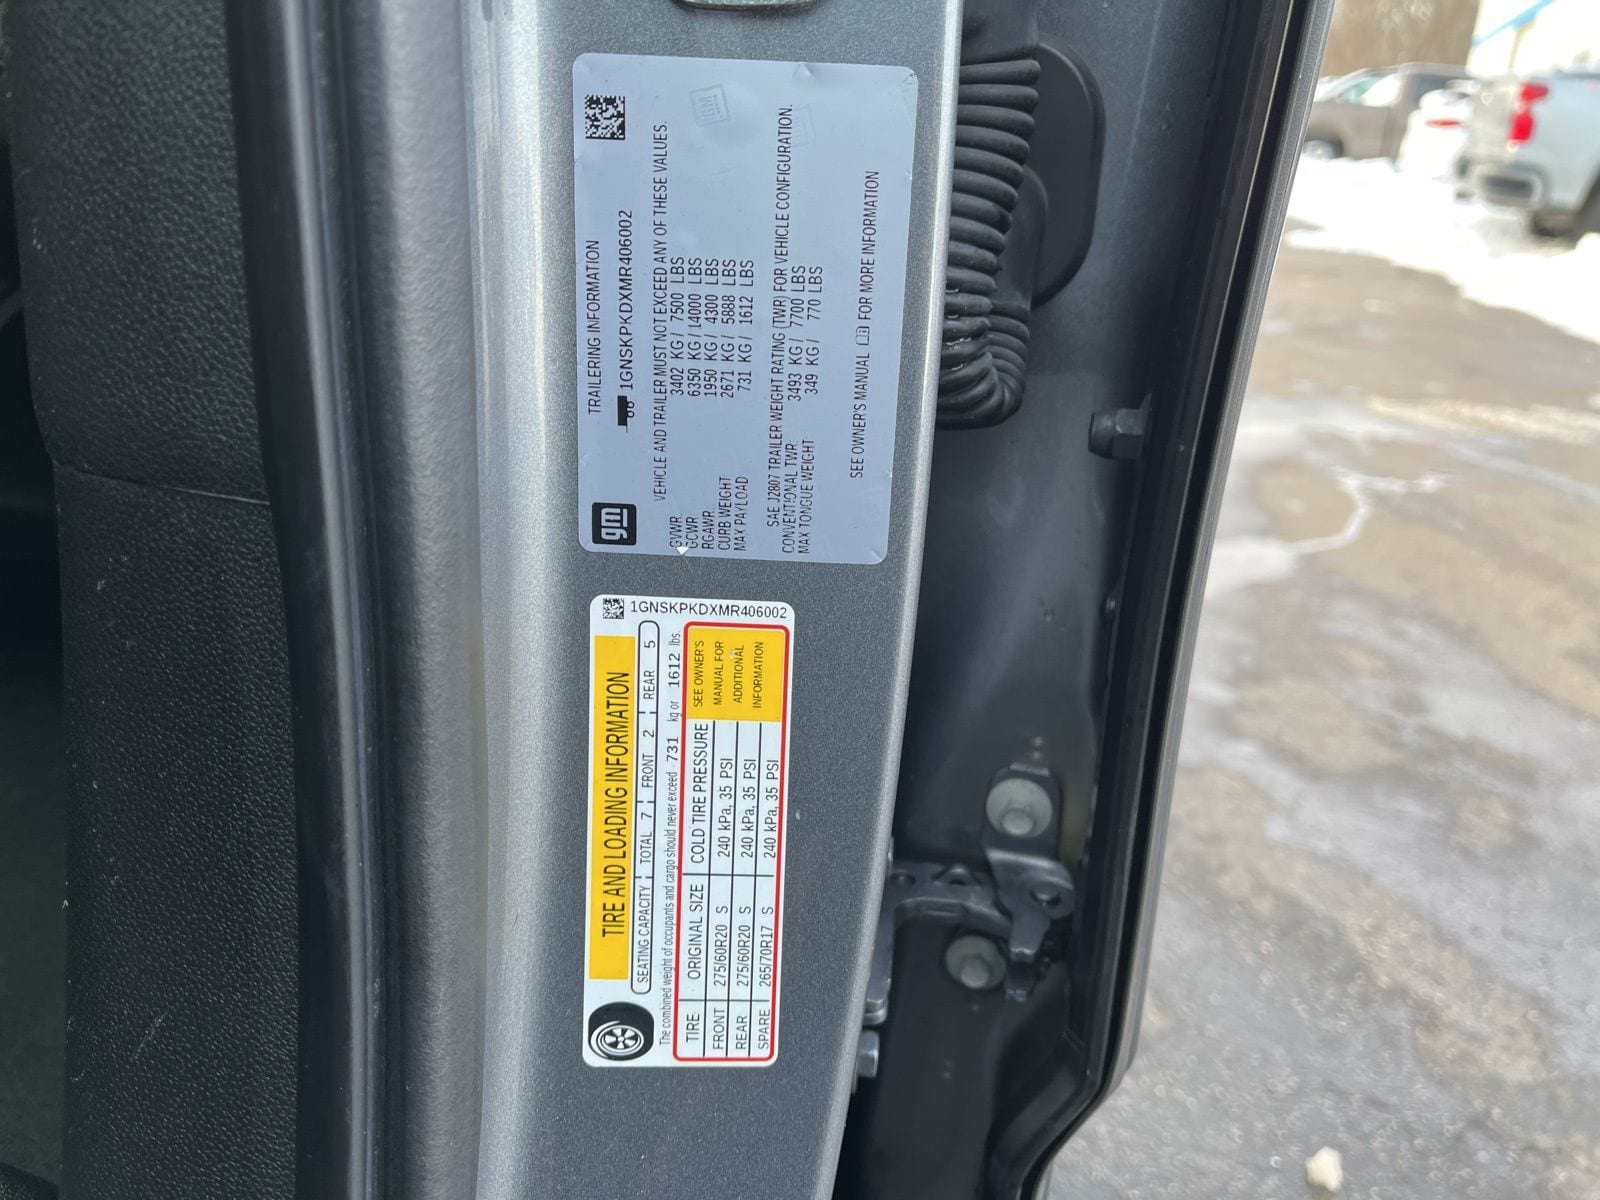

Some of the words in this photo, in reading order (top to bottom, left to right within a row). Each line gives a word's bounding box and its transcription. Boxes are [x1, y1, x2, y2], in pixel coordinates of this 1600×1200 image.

[653, 121, 667, 172] VALUES.
[776, 104, 792, 210] CONFIGURATION.
[653, 177, 667, 216] THESE
[653, 220, 667, 235] OF
[861, 171, 879, 255] INFORMATION
[653, 240, 667, 263] ANY
[775, 214, 789, 263] VEHICLE
[671, 257, 684, 283] LBS
[688, 258, 702, 284] LBS
[705, 258, 718, 285] LBS
[722, 259, 736, 286] LBS
[739, 260, 753, 286] LBS
[773, 268, 787, 291] FOR
[791, 265, 805, 292] LBS
[808, 266, 822, 293] LBS
[859, 259, 874, 293] MORE
[586, 240, 600, 333] INFORMATION
[618, 210, 633, 390] 1GNSKPKDXMR406002
[654, 268, 667, 313] EXCEED
[670, 293, 685, 321] 7500
[688, 294, 701, 327] 14000
[704, 295, 718, 324] 4300
[721, 295, 735, 324] 5888
[739, 296, 753, 325] 1612
[772, 296, 790, 328] (TWR)
[790, 298, 804, 327] 7700
[807, 299, 820, 320] 770
[857, 297, 872, 320] FOR
[654, 318, 667, 341] NOT
[654, 346, 667, 376] MUST
[771, 333, 785, 374] RATING
[587, 338, 601, 414] TRAILERING
[670, 367, 684, 395] 3402
[687, 369, 701, 396] 6350
[704, 369, 717, 397] 1950
[720, 370, 734, 398] 2671
[738, 371, 751, 391] 731
[787, 373, 801, 401] 3493
[804, 374, 818, 395] 349
[854, 353, 869, 400] MANUAL
[653, 380, 667, 425] TRAILER
[770, 379, 783, 421] WEIGHT
[653, 430, 667, 452] AND
[852, 404, 867, 454] OWNER'S
[768, 425, 782, 470] TRAILER
[801, 439, 814, 481] WEIGHT
[653, 457, 667, 501] VEHICLE
[850, 459, 864, 478] SEE
[719, 476, 731, 517] WEIGHT
[734, 476, 748, 525] PAYLOAD
[768, 474, 780, 503] J2807
[767, 507, 780, 527] SAE
[782, 472, 798, 553] CONVENTIONAL
[799, 485, 813, 527] TONGUE
[601, 508, 628, 540] gm
[718, 521, 731, 550] CURB
[734, 529, 746, 551] MAX
[798, 532, 810, 553] MAX
[631, 601, 787, 618] 1GNSKPKDXMR406002
[694, 640, 704, 685] OWNER'S
[715, 641, 723, 661] FOR
[643, 670, 655, 699] REAR
[668, 653, 680, 688] 1612
[714, 665, 723, 705] MANUAL
[733, 645, 744, 703] ADDITIONAL
[753, 642, 763, 708] INFORMATION
[670, 701, 679, 709] or
[693, 689, 703, 707] SEE
[605, 672, 629, 782] INFORMATION
[667, 713, 682, 722] kg
[667, 737, 678, 762] 731
[693, 724, 708, 792] PRESSURE
[641, 753, 653, 787] FRONT
[720, 758, 733, 778] PSI
[743, 759, 756, 779] PSI
[767, 760, 779, 780] PSI
[666, 772, 677, 801] exceed
[719, 786, 732, 800] 35
[743, 787, 755, 800] 35
[766, 787, 778, 801] 35
[604, 787, 627, 858] LOADING
[668, 803, 677, 826] never
[692, 797, 706, 824] TIRE
[718, 805, 733, 830] kPa,
[741, 806, 756, 831] kPa,
[764, 806, 778, 832] kPa,
[640, 832, 652, 864] TOTAL
[665, 830, 676, 857] should
[691, 829, 705, 863] COLD
[717, 837, 730, 857] 240
[741, 837, 754, 858] 240
[764, 838, 776, 858] 240
[603, 865, 625, 897] AND
[666, 860, 678, 883] cargo
[663, 885, 674, 900] and
[690, 884, 704, 912] SIZE
[602, 903, 624, 937] TIRE
[638, 886, 651, 936] CAPACITY
[664, 902, 676, 945] occupants
[715, 906, 728, 914] S
[739, 906, 751, 914] S
[762, 907, 773, 915] S
[637, 940, 649, 983] SEATING
[662, 947, 672, 956] of
[687, 917, 702, 979] ORIGINAL
[714, 924, 727, 987] 275/60R20
[736, 925, 750, 987] 275/60R20
[759, 925, 773, 987] 265/70R17
[661, 959, 675, 985] weight
[660, 988, 671, 1028] combined
[659, 1031, 670, 1045] The
[686, 1014, 700, 1042] TIRE
[713, 1008, 725, 1049] FRONT
[736, 1016, 747, 1050] REAR
[759, 1009, 770, 1049] SPARE
